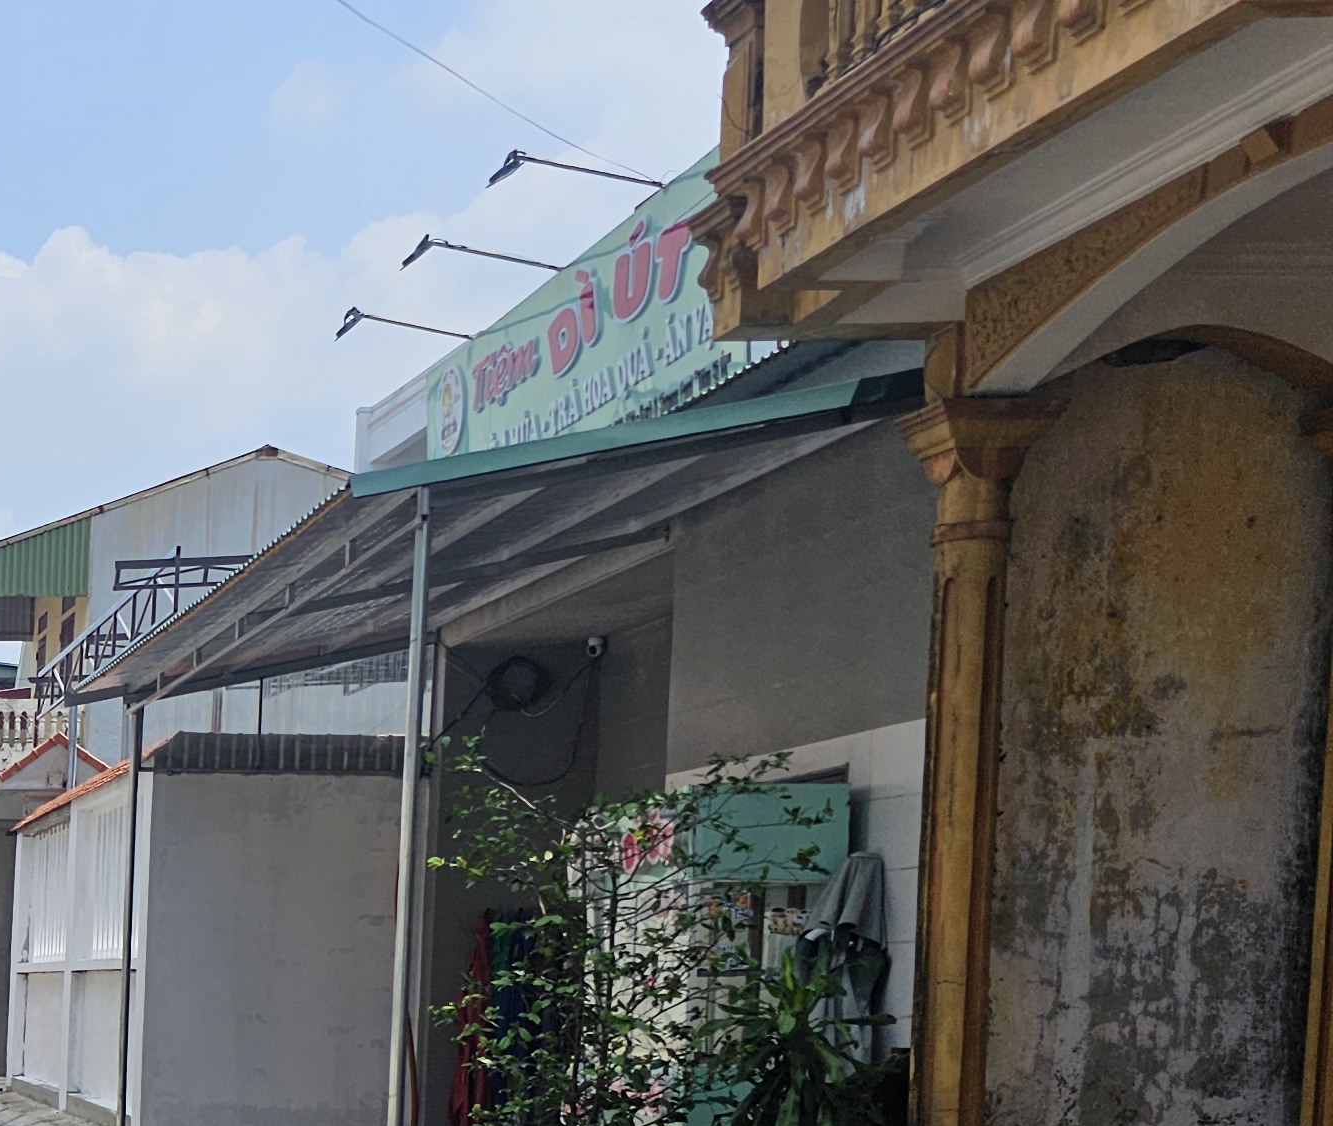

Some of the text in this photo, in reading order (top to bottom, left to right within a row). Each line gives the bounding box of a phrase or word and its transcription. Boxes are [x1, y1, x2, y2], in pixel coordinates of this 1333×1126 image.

[472, 335, 539, 413] Tiệm
[546, 269, 598, 378] DÌ
[612, 219, 693, 323] ÚT
[585, 367, 614, 416] HOA
